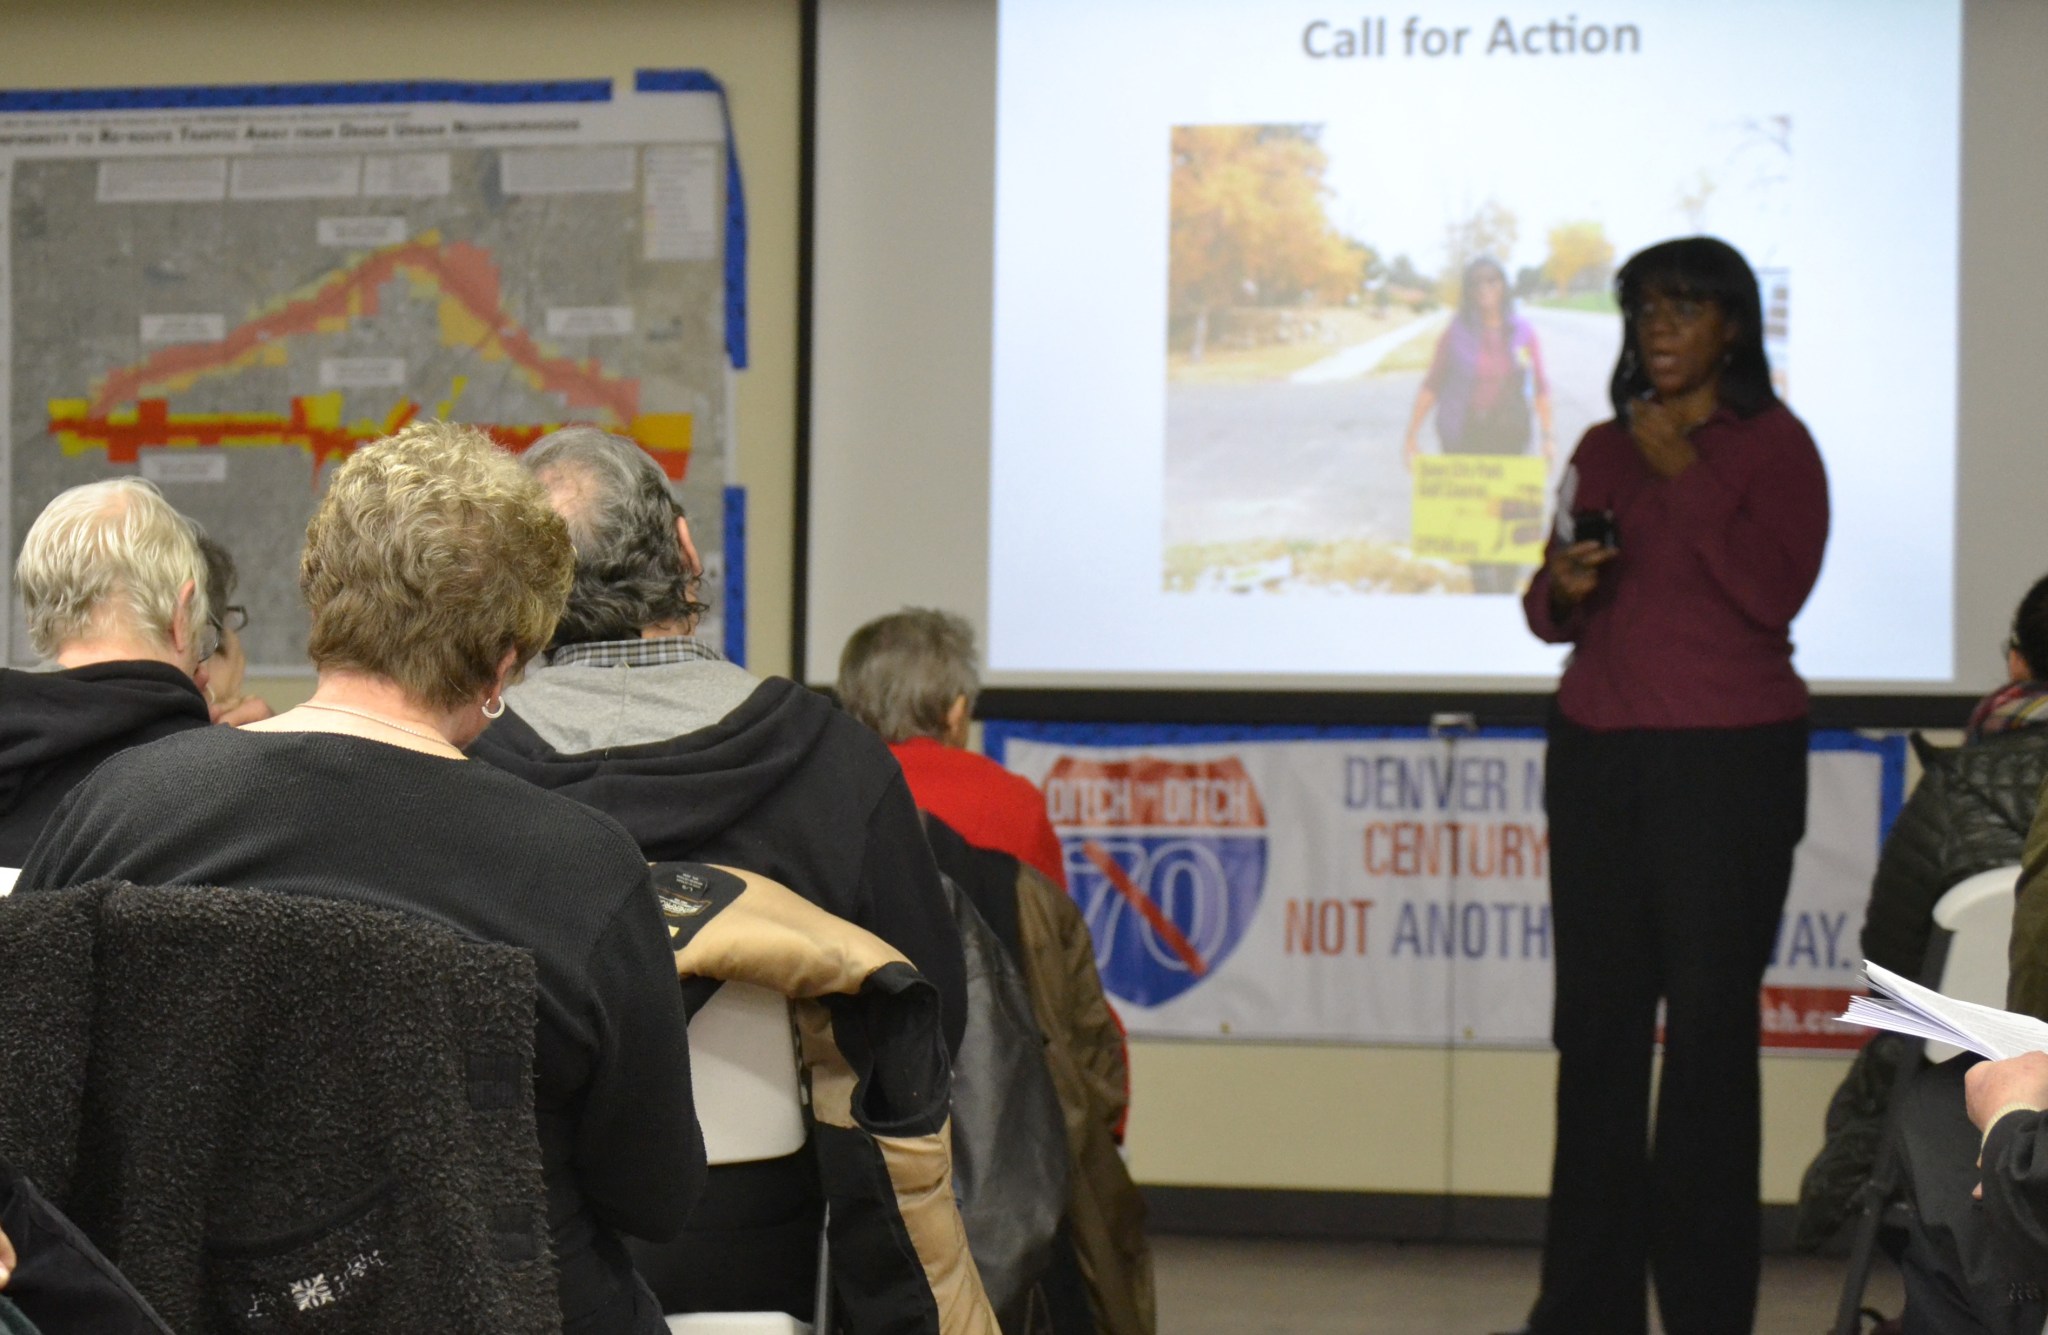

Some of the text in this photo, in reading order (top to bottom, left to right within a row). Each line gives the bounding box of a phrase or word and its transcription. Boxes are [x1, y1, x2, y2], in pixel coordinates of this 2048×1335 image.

[1301, 14, 1641, 59] Call for Action
[1047, 778, 1131, 824] DITCH
[1163, 777, 1249, 824] DITCH
[1343, 757, 1506, 811] DENVER
[1364, 820, 1548, 877] CENTURY
[1064, 839, 1229, 973] 70
[1284, 898, 1552, 959] NOT ANOTH
